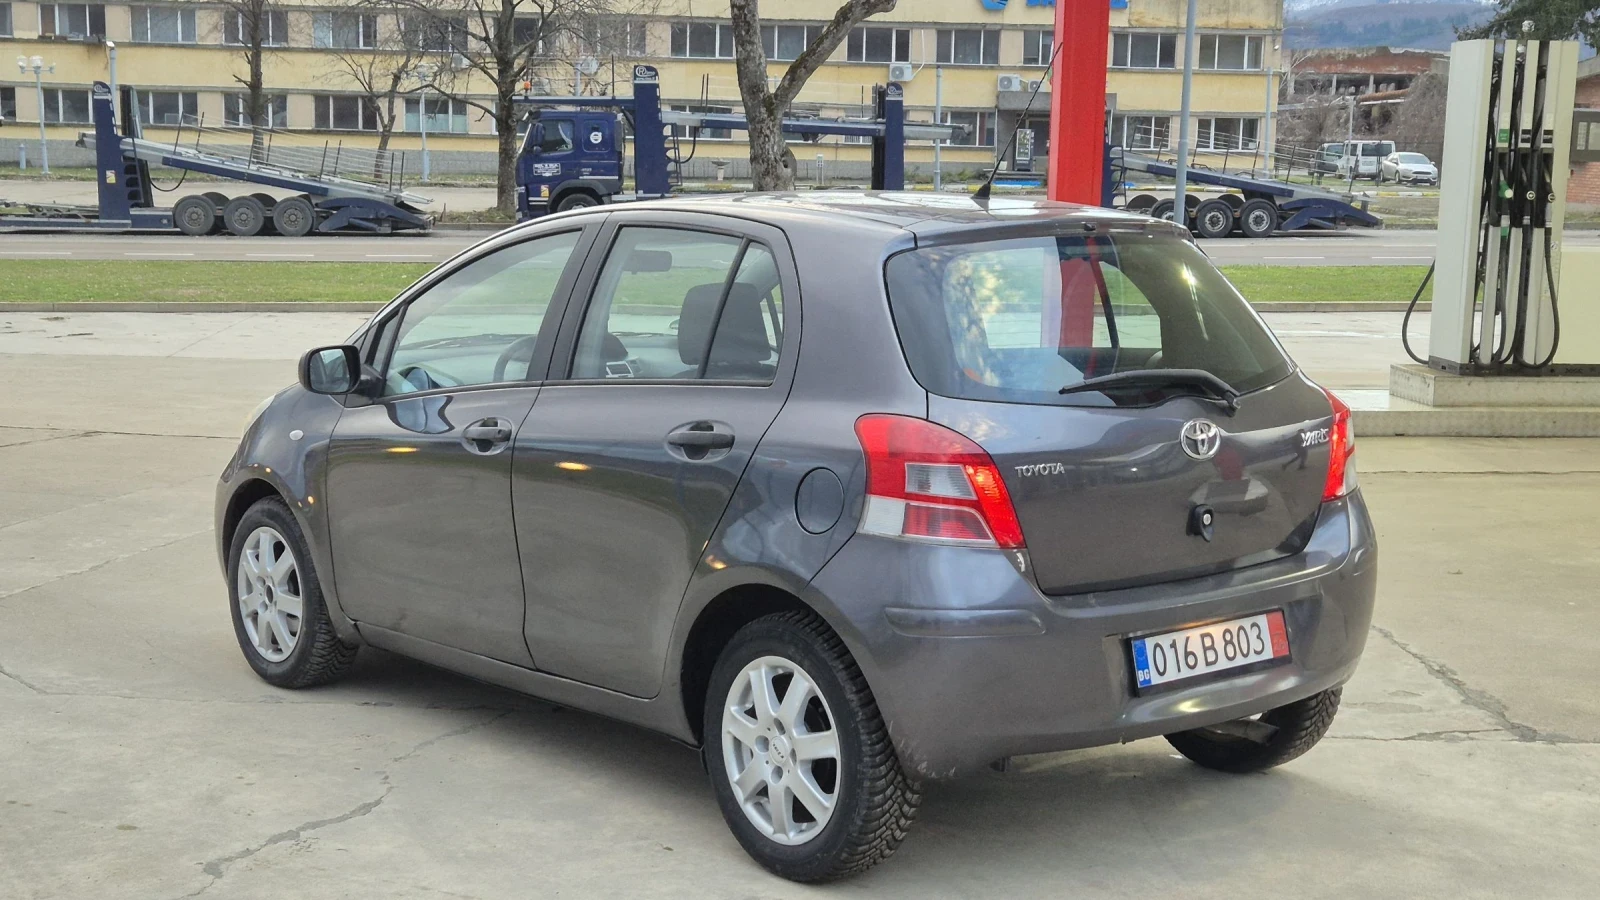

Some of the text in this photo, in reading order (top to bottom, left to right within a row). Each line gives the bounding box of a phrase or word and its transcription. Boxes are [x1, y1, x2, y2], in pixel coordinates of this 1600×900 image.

[1300, 428, 1329, 447] YARIS
[1014, 462, 1065, 478] TOYOTA
[1137, 669, 1151, 681] BG
